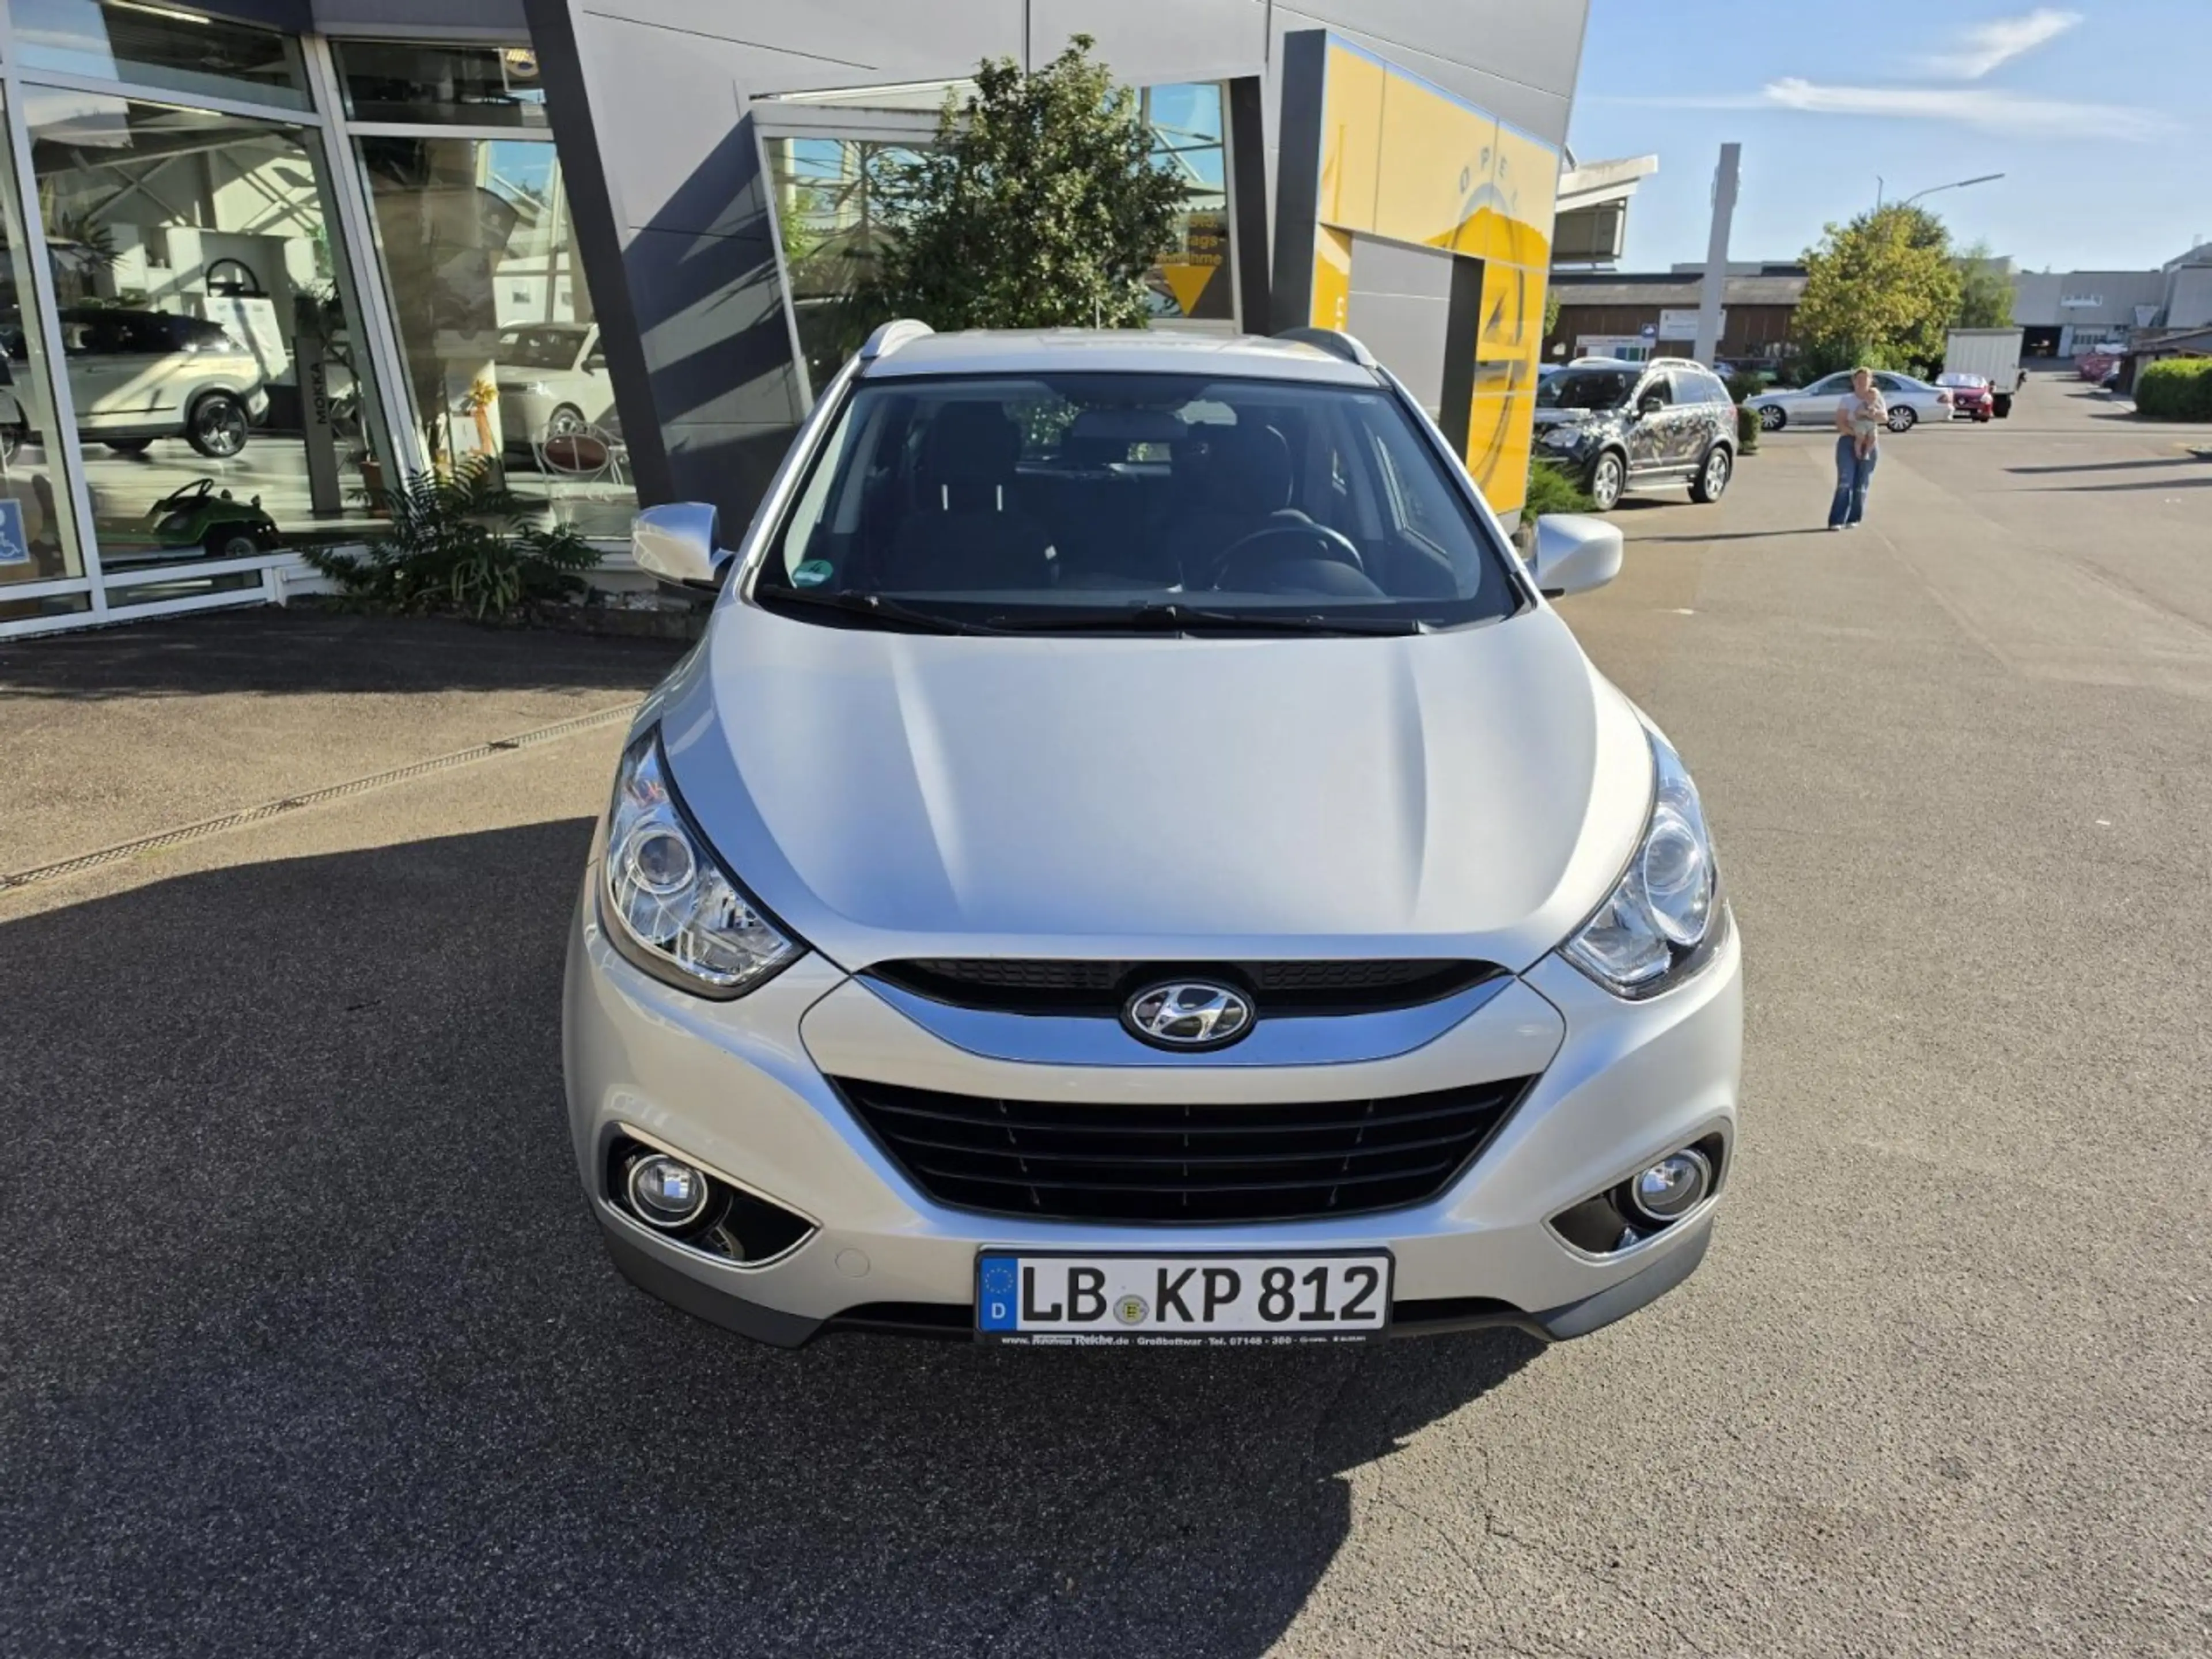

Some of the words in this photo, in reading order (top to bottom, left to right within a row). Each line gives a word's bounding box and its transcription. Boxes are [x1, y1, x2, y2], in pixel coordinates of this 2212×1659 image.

[310, 362, 327, 424] MOKKA
[991, 1302, 1006, 1319] D
[1022, 1266, 1107, 1321] LB
[1156, 1267, 1241, 1322] KP
[1257, 1266, 1379, 1322] 812
